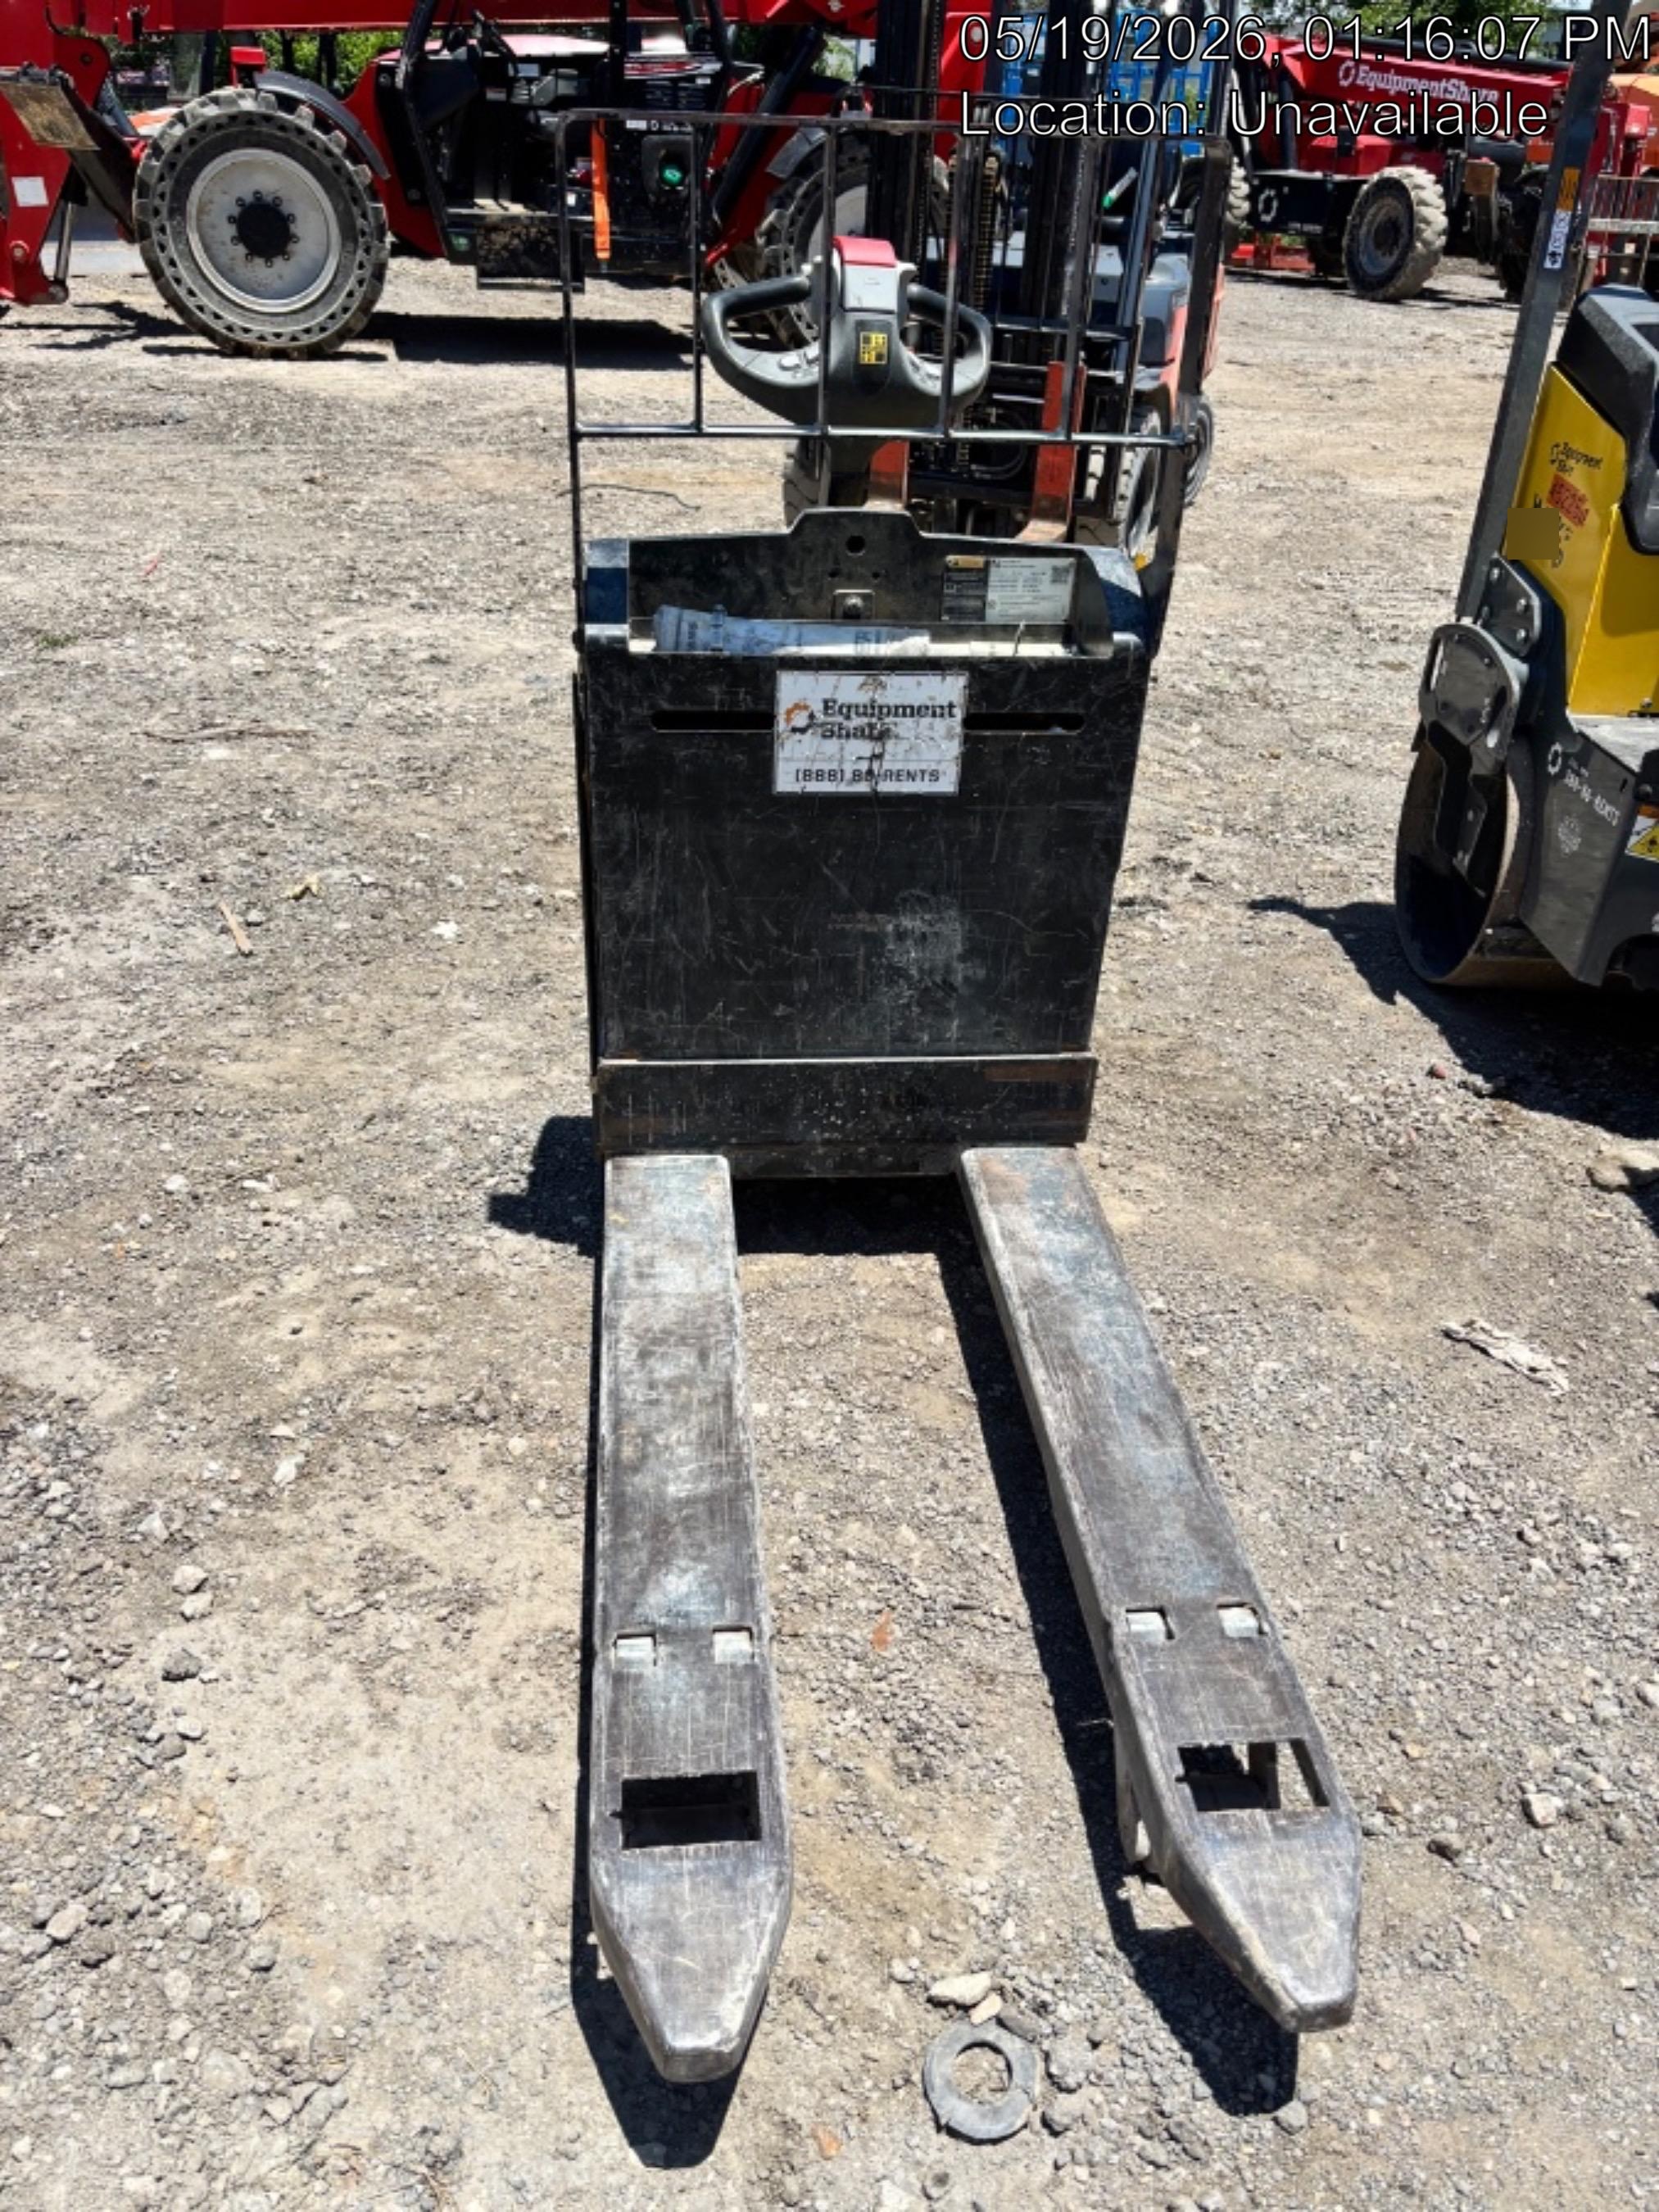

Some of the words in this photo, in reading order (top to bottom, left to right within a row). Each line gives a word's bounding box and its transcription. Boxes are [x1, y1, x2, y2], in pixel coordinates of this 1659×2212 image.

[1356, 64, 1499, 104] EquipmentShre
[822, 697, 957, 720] Equipment
[795, 768, 844, 782] (888)
